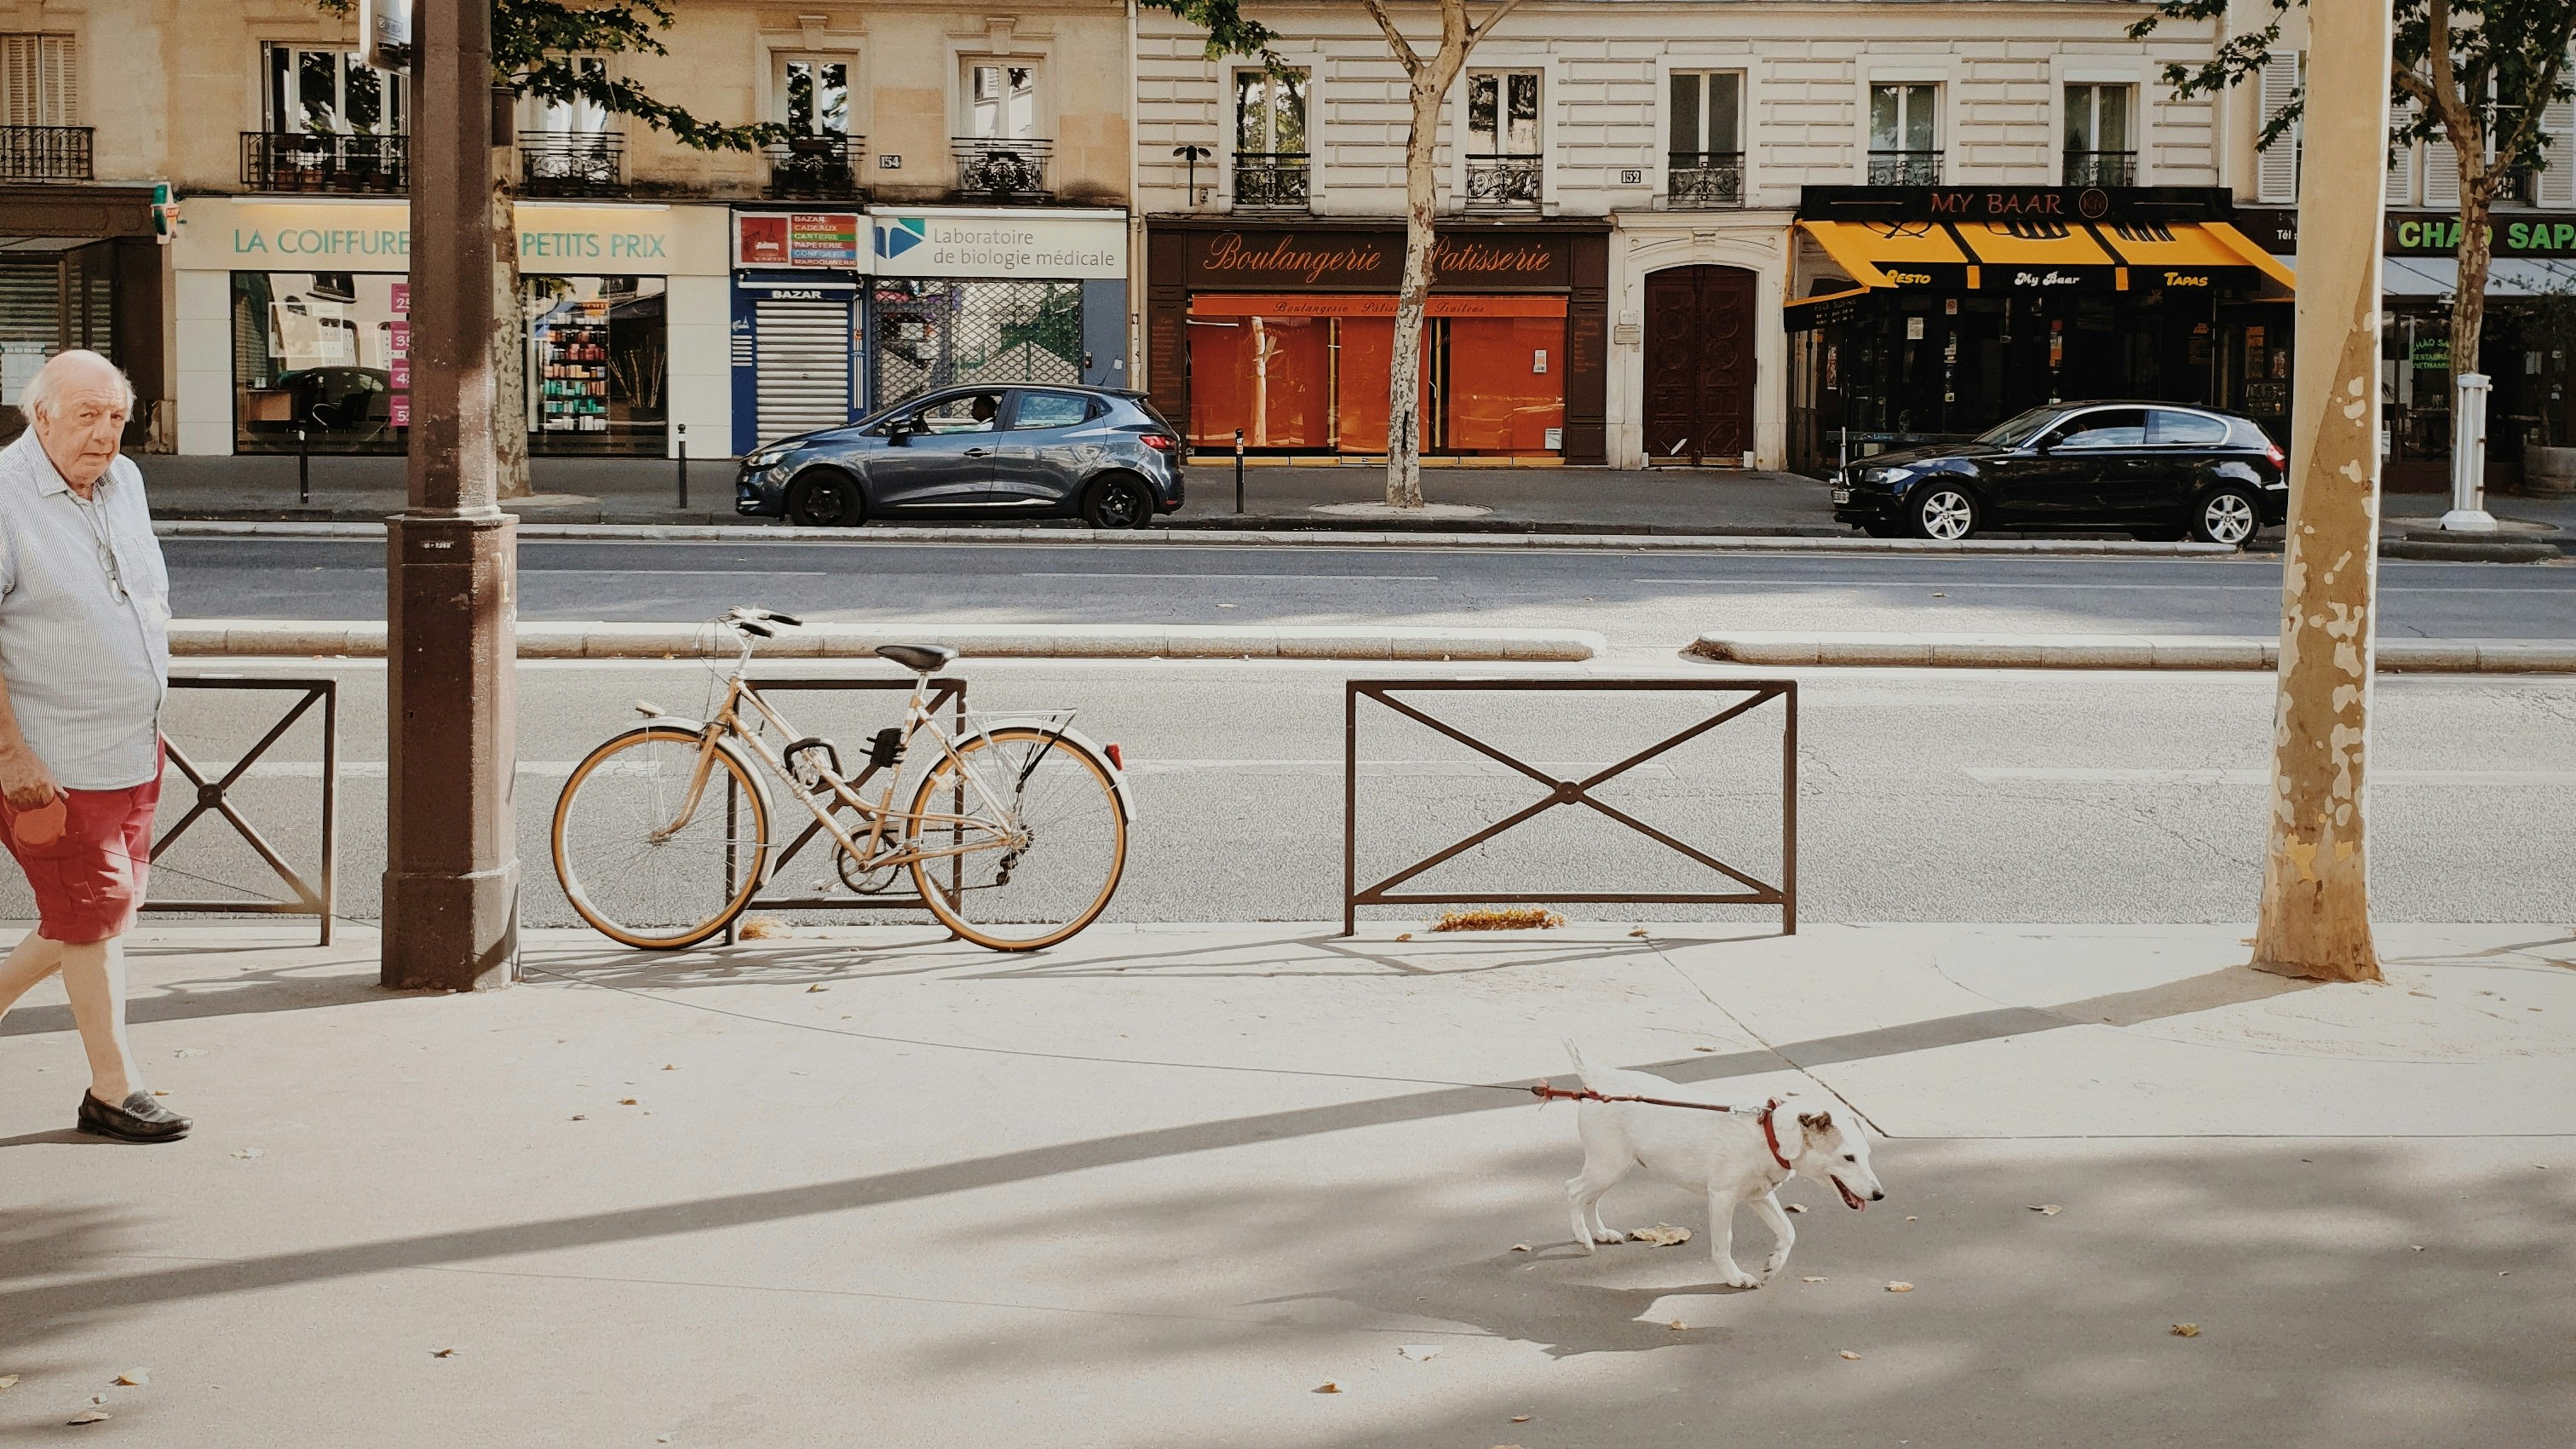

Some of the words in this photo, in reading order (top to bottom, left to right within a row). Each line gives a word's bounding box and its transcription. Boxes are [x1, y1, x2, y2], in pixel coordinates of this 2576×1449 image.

[881, 156, 900, 168] 154
[1623, 170, 1640, 183] 152
[1931, 193, 1974, 213] MY
[1987, 193, 2064, 214] BAAR
[934, 227, 1034, 245] Laboratoire
[2399, 216, 2493, 247] CHÀ
[234, 229, 268, 253] LA
[278, 229, 410, 254] COIFFURE
[522, 233, 600, 257] PETITS
[612, 234, 666, 257] PRIX
[934, 249, 955, 264] de
[961, 249, 1031, 270] biologie
[1037, 250, 1115, 267] médicale
[1204, 233, 1382, 284] Boulangerie
[2015, 272, 2039, 287] My
[2043, 271, 2080, 285] Baar
[772, 290, 822, 300] BAZAR
[1273, 301, 1348, 315] Boulangerie
